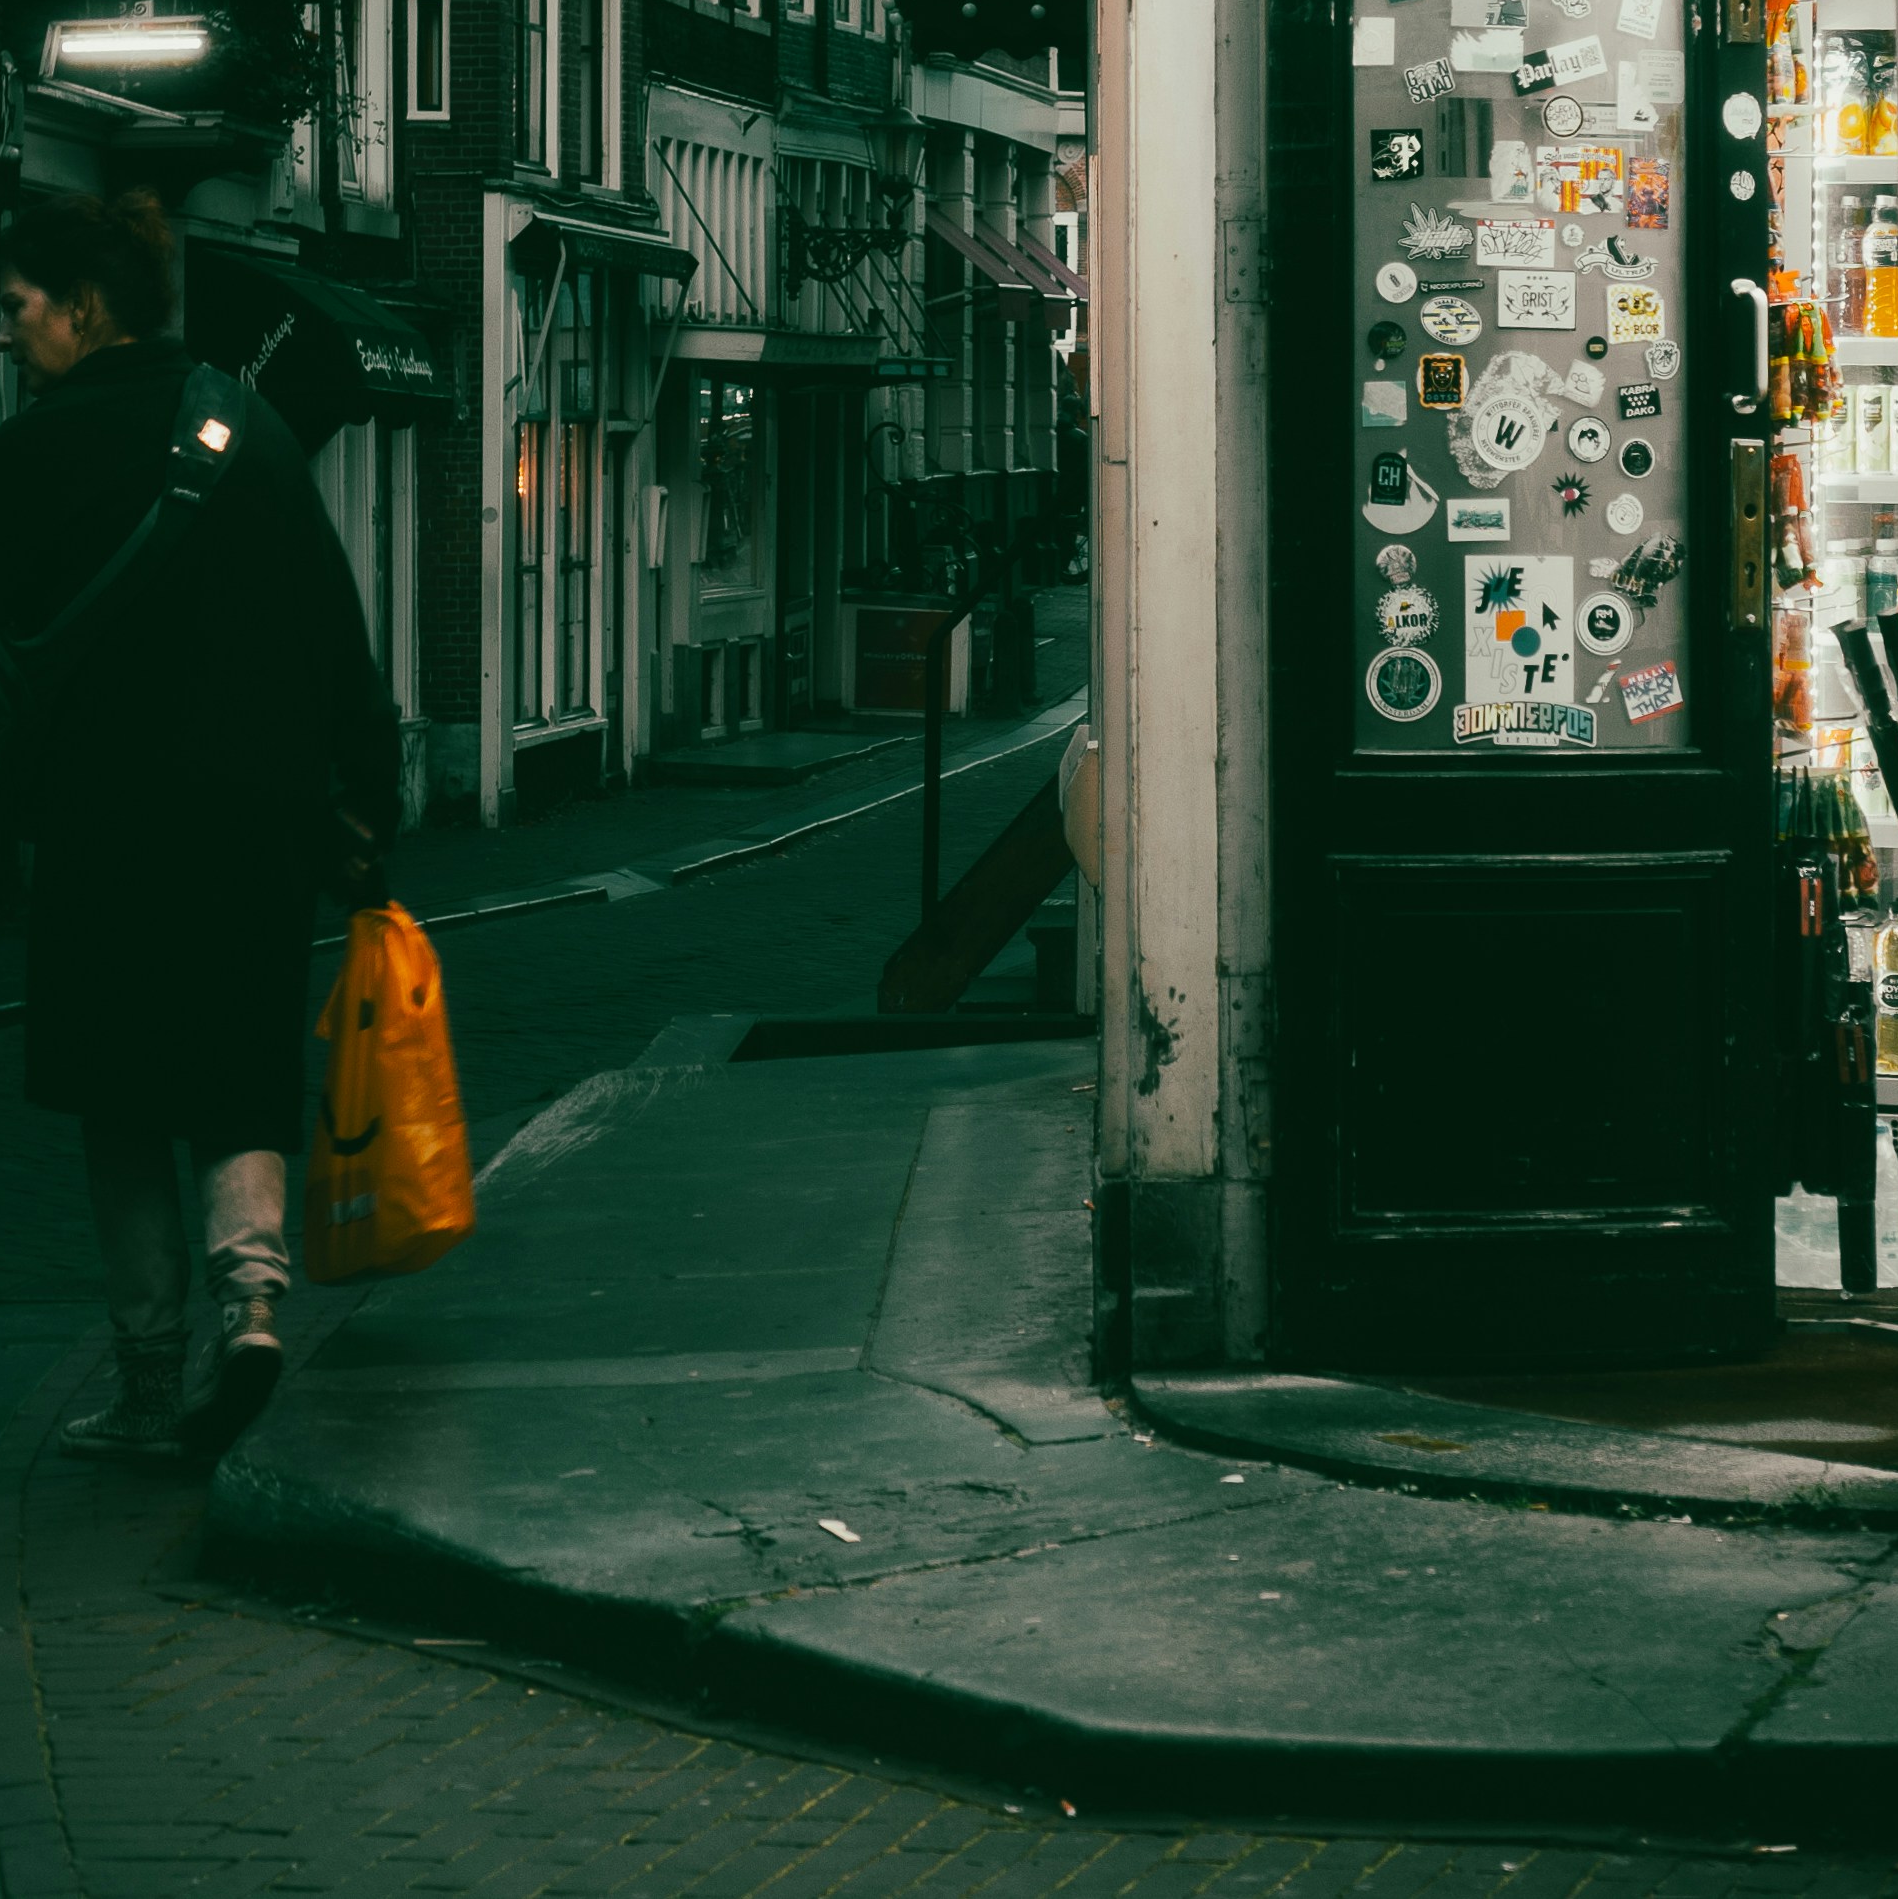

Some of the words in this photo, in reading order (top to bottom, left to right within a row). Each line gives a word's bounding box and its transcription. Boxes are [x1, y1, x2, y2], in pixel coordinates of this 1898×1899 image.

[1521, 292, 1554, 309] GRIST
[1619, 383, 1657, 397] KABRA
[1625, 404, 1657, 417] DAKO
[1494, 415, 1526, 451] W
